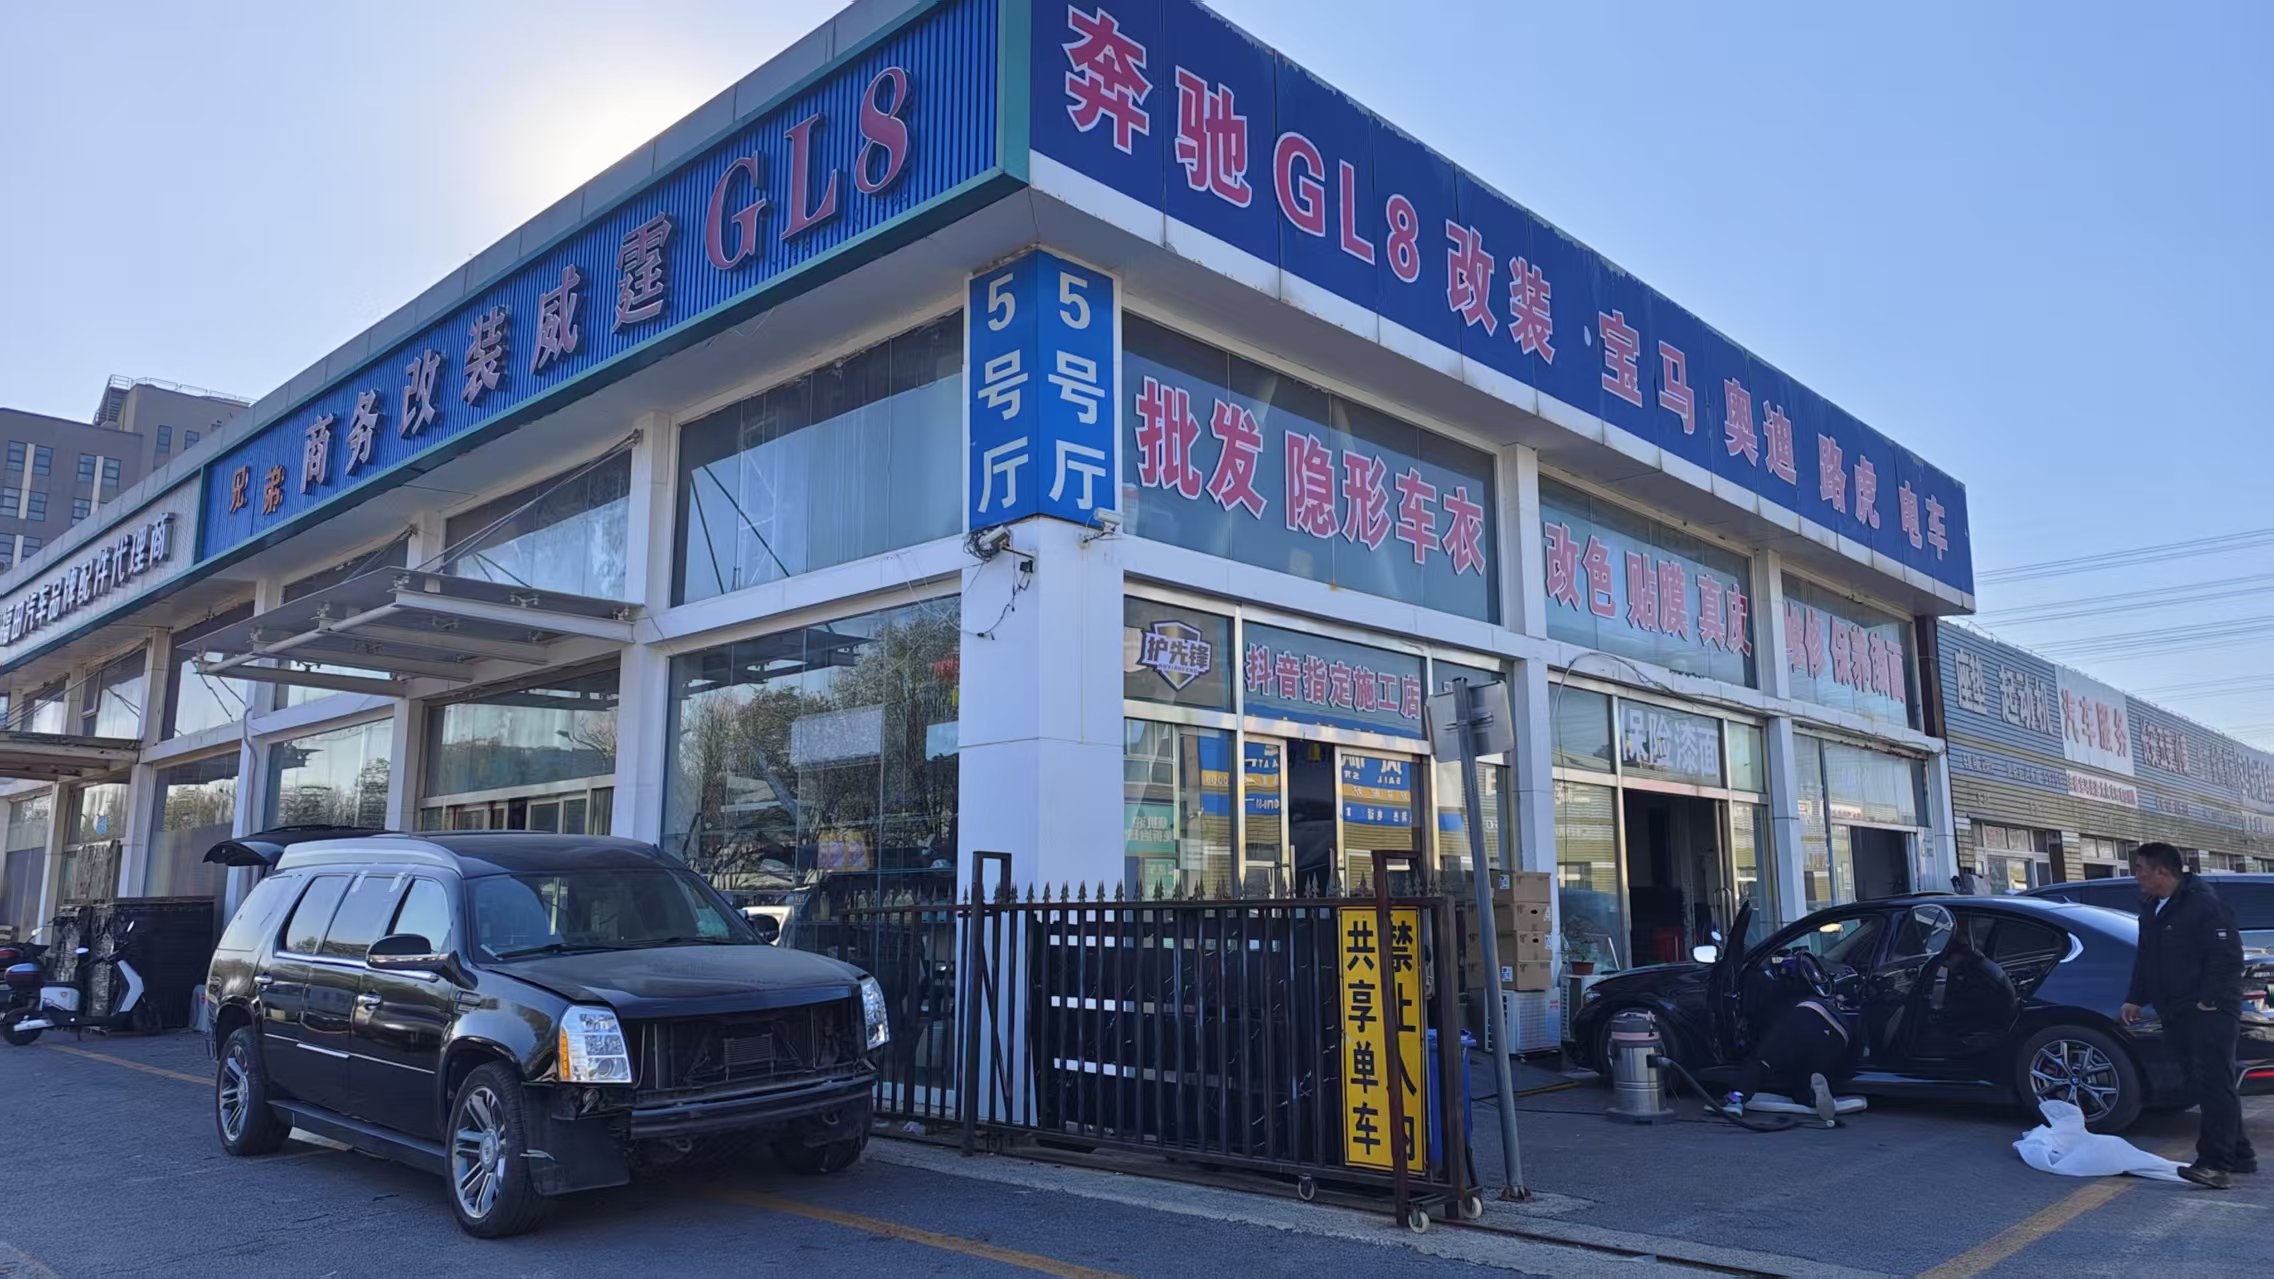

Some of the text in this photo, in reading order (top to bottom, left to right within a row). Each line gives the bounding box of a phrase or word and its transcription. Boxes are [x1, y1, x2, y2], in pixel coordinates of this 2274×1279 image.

[1061, 4, 1949, 561] 奔驰GL8改装 宝马 奥迪 路虎 电车
[228, 463, 285, 516] 兄弟
[977, 272, 1030, 514] 5号厅
[1047, 270, 1107, 512] 5号厅
[1134, 375, 1487, 577] 批发 隐形车衣
[1244, 642, 1422, 720] 抖音指定施工店
[1543, 522, 1753, 659] 改色 贴膜 真皮
[1620, 704, 1720, 777] 保险漆面
[1346, 920, 1381, 1156] 共享单车
